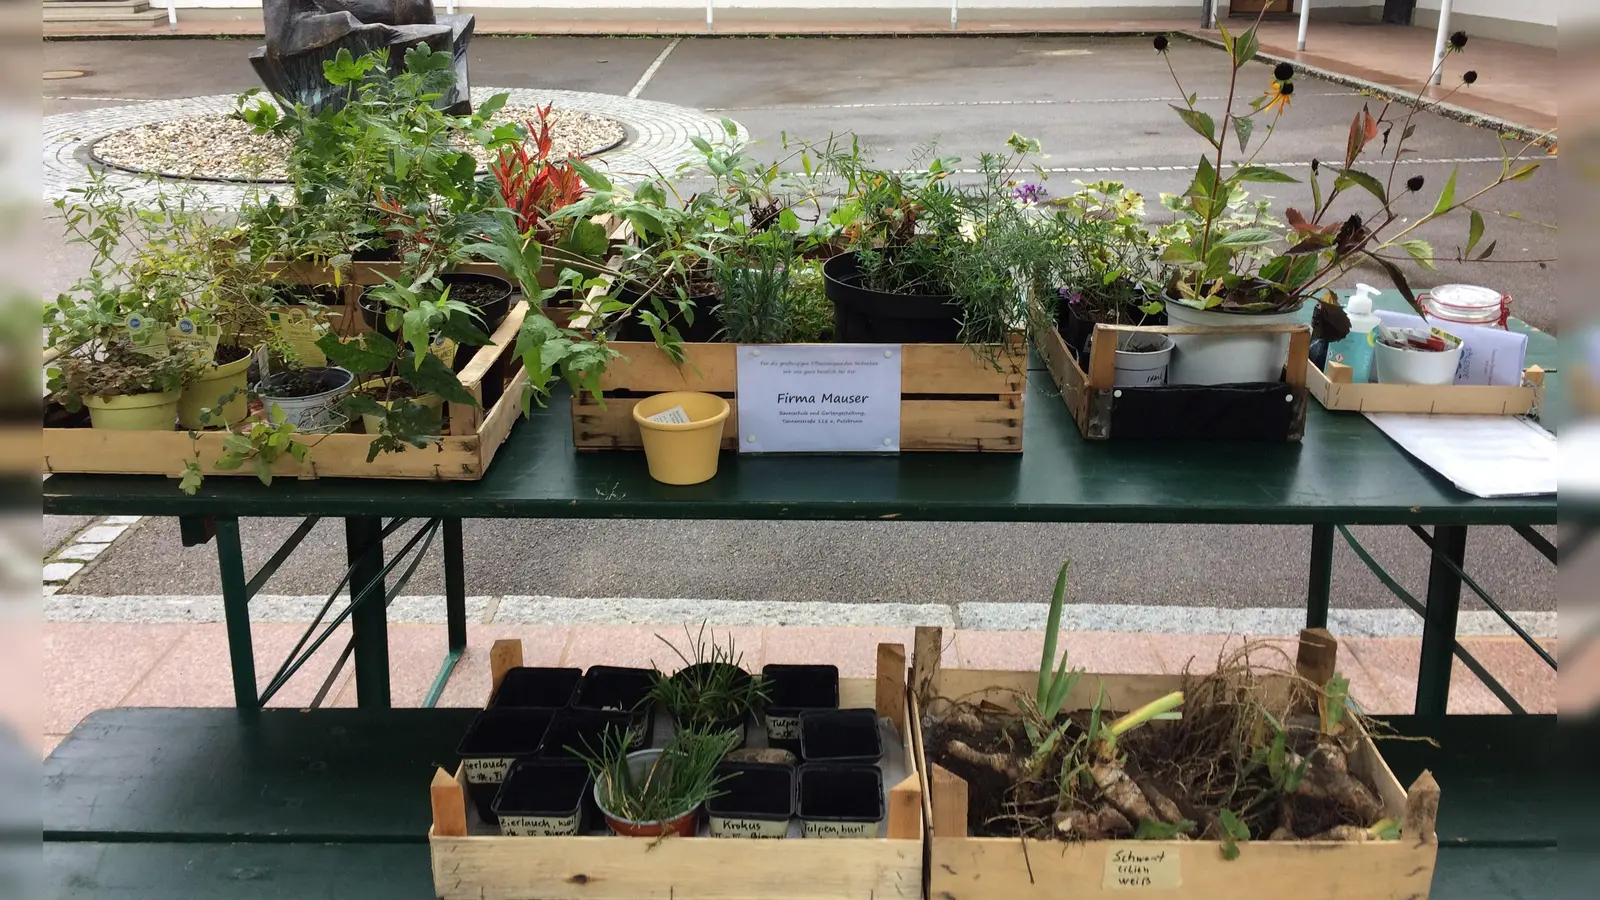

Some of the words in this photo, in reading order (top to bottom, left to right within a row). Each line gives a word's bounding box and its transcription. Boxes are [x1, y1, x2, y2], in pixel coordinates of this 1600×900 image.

[777, 392, 816, 404] Firma
[821, 393, 869, 404] Mauser
[464, 758, 507, 770] ierlauch
[500, 817, 556, 829] Zierlauch,
[723, 819, 762, 831] Krokus
[803, 823, 839, 836] Tulpen,
[841, 823, 866, 834] bunt
